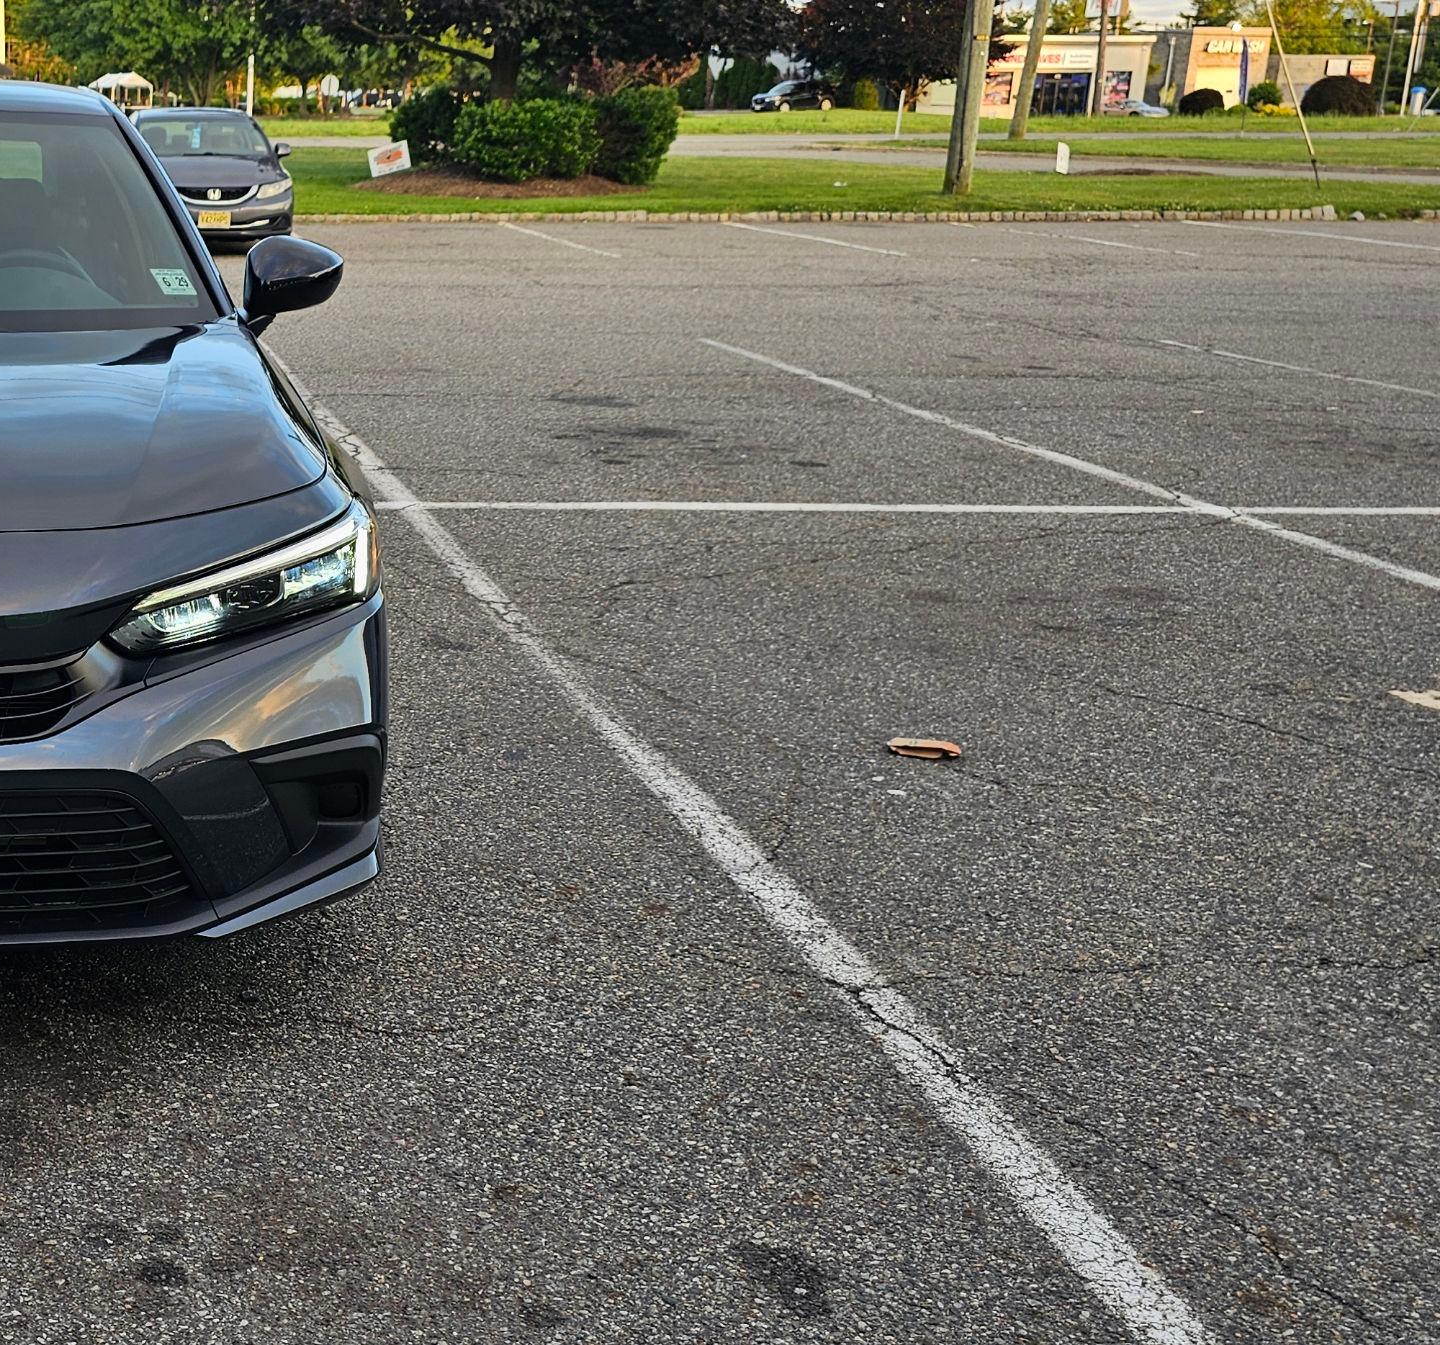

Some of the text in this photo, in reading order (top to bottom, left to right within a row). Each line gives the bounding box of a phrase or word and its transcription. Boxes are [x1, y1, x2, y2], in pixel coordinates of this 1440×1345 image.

[1207, 39, 1233, 54] CAR
[162, 276, 189, 287] 6 29
